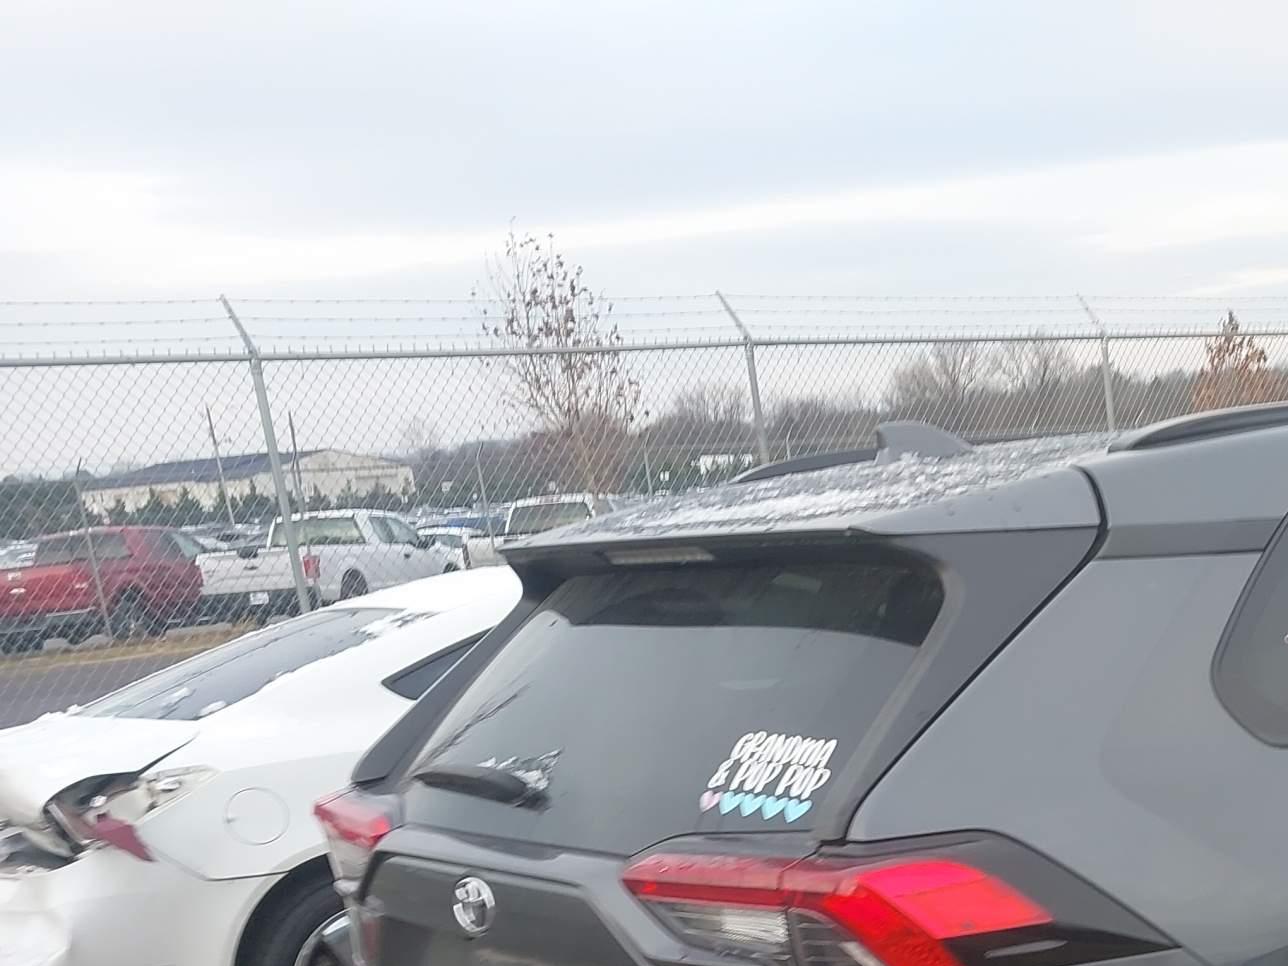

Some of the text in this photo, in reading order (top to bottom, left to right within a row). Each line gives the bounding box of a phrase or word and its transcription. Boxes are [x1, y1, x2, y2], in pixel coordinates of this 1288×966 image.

[730, 731, 838, 769] GRANDMA
[707, 758, 832, 801] & POP POP
